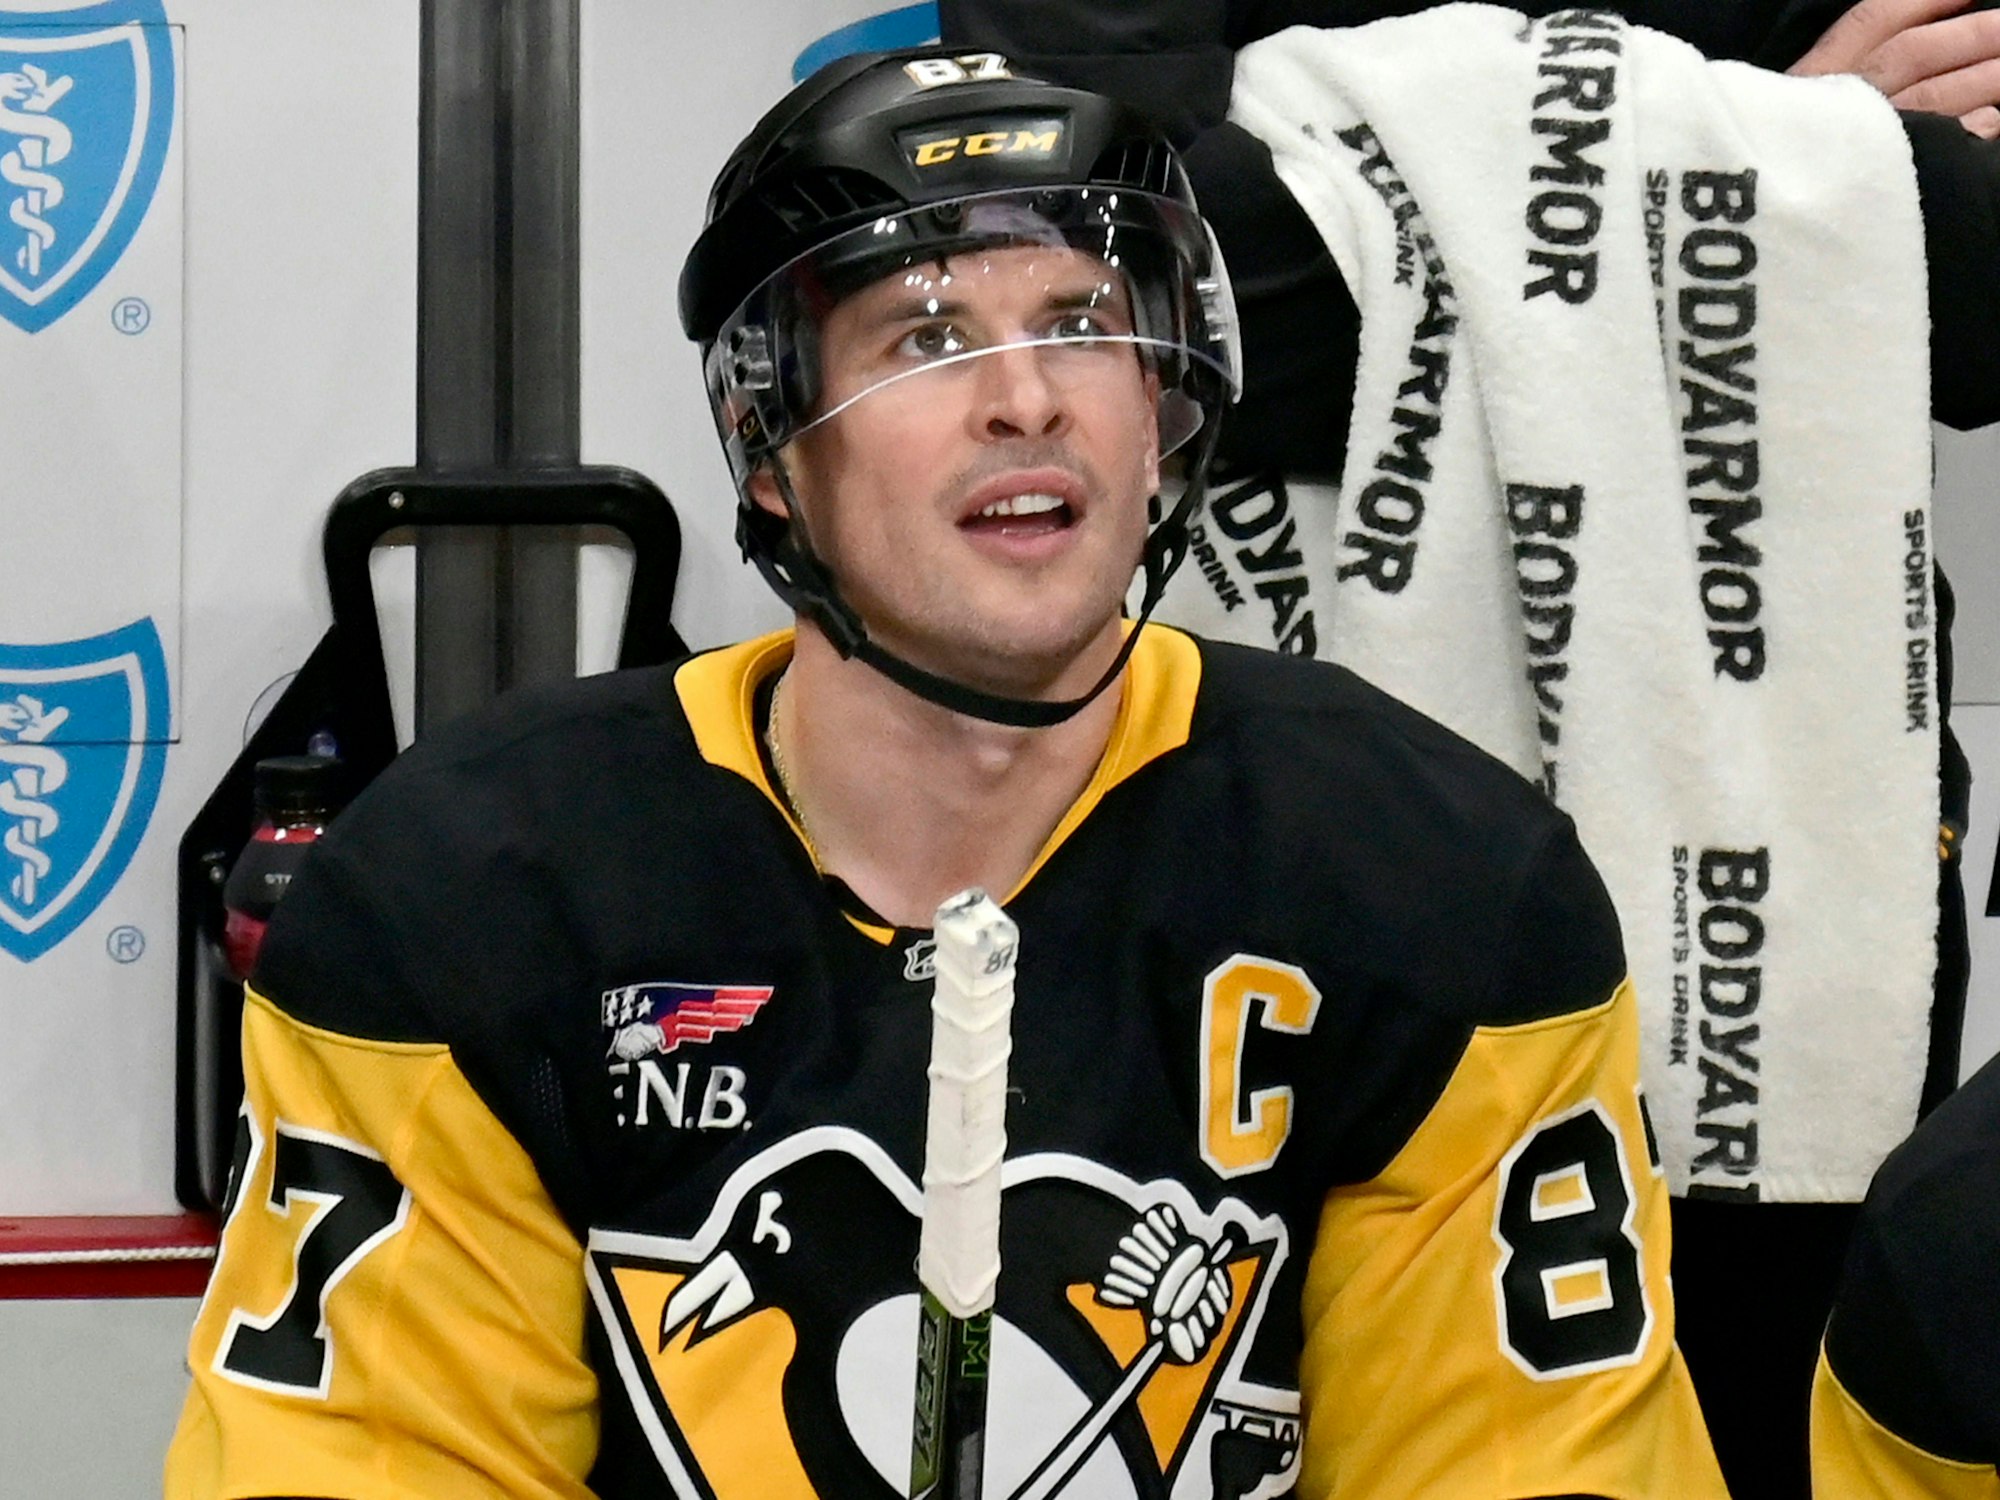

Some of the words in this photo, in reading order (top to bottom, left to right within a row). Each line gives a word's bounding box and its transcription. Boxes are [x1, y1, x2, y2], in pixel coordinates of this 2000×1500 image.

[903, 52, 1015, 89] 87
[915, 130, 1058, 167] CCM
[1679, 166, 1767, 682] BODYARMOR
[1189, 523, 1247, 613] DRINK
[1904, 508, 1928, 630] SPORTS
[1906, 638, 1930, 733] DRINK
[1671, 845, 1690, 963] SPORTS
[1199, 952, 1323, 1181] C
